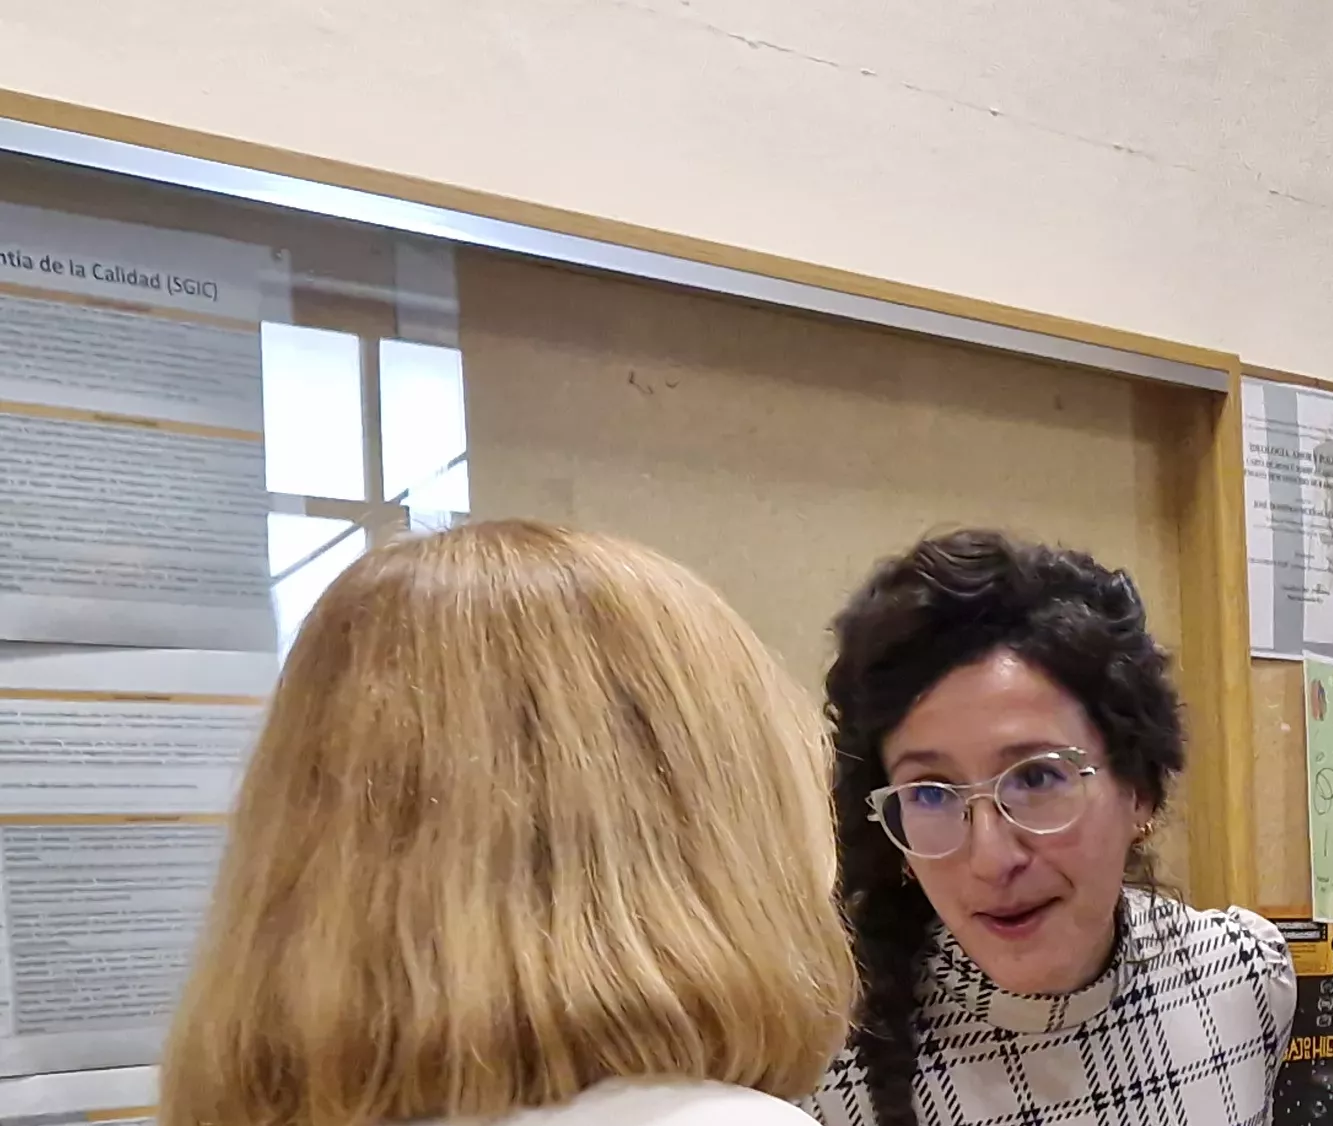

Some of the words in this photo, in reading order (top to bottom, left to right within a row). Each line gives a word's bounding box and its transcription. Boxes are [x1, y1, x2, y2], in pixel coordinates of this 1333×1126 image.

[40, 255, 63, 275] de
[70, 259, 86, 278] la
[93, 263, 161, 289] Calidad
[167, 275, 218, 301] (SGIC)
